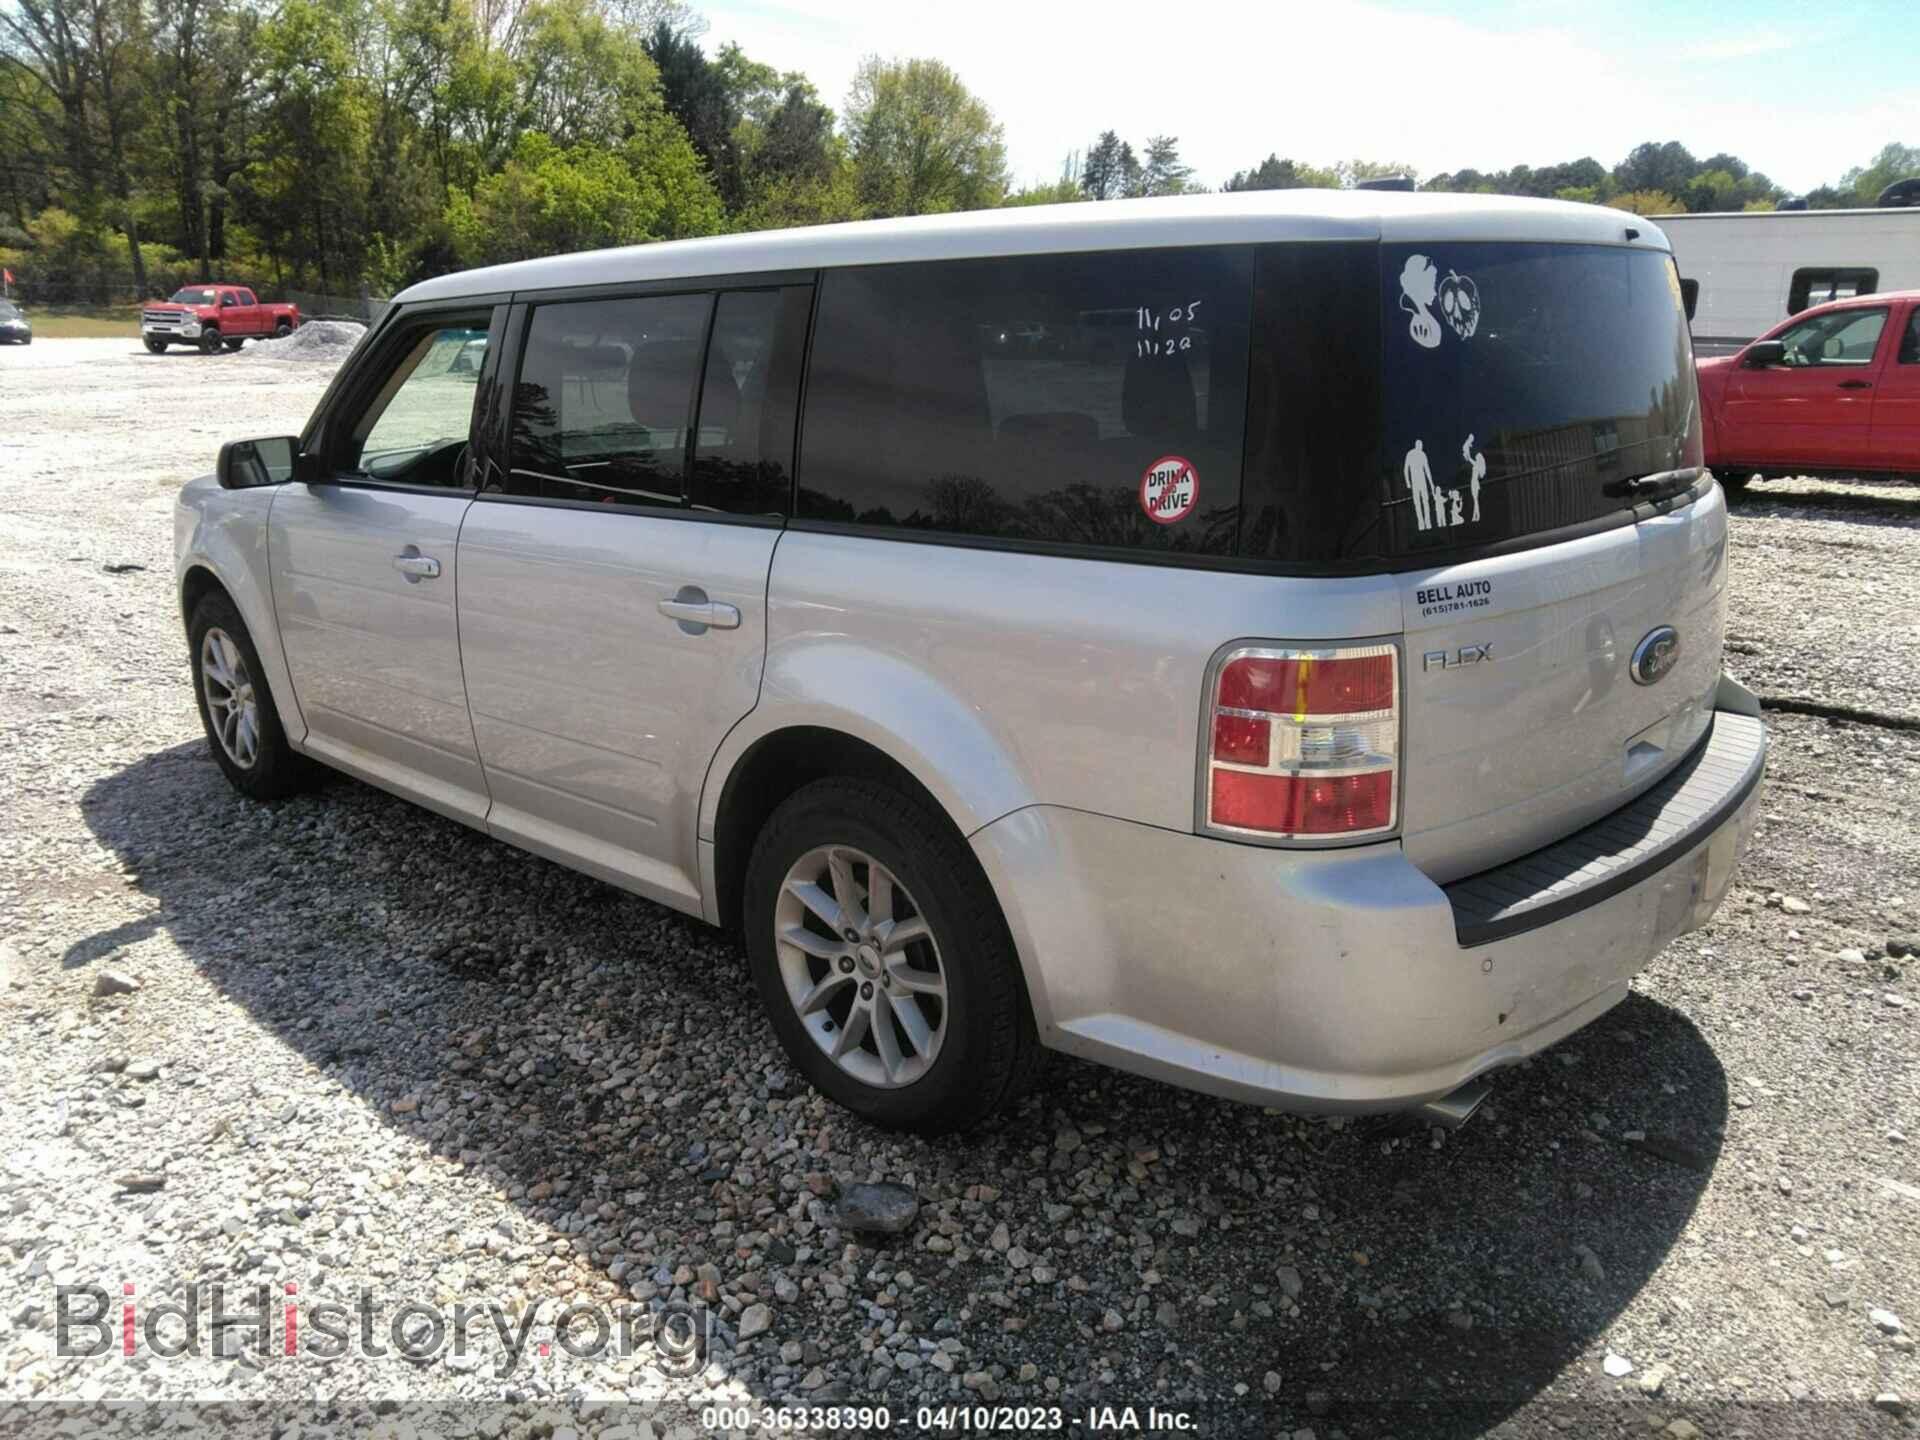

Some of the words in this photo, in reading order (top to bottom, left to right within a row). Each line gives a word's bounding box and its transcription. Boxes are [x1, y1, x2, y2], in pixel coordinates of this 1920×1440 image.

[1148, 468, 1190, 488] DRINK
[1149, 493, 1189, 511] DRIVE
[1416, 586, 1453, 605] BELL
[1456, 580, 1492, 599] AUTO
[1423, 642, 1494, 673] FLEX
